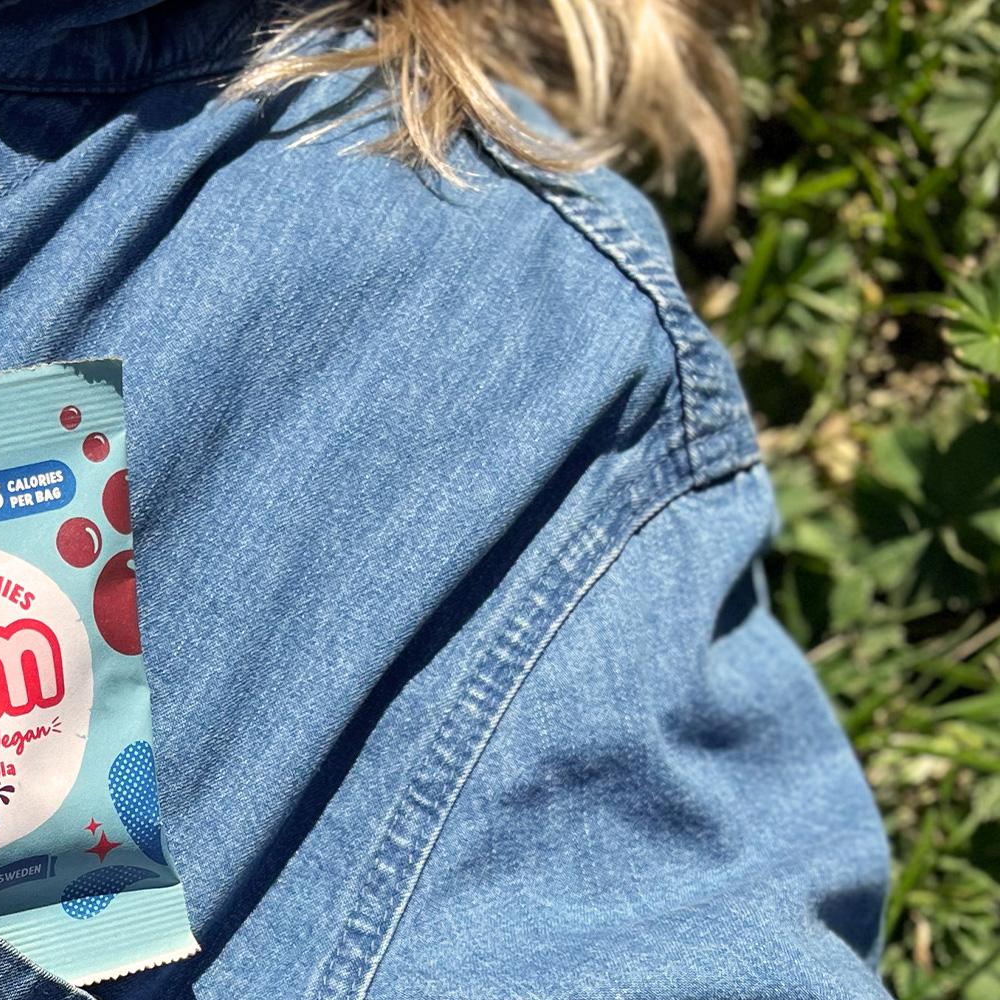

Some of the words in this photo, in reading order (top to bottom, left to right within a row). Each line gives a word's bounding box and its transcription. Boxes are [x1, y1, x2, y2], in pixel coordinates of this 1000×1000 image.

[7, 470, 64, 493] CALORIES
[9, 493, 34, 509] PER
[35, 487, 62, 503] BAG
